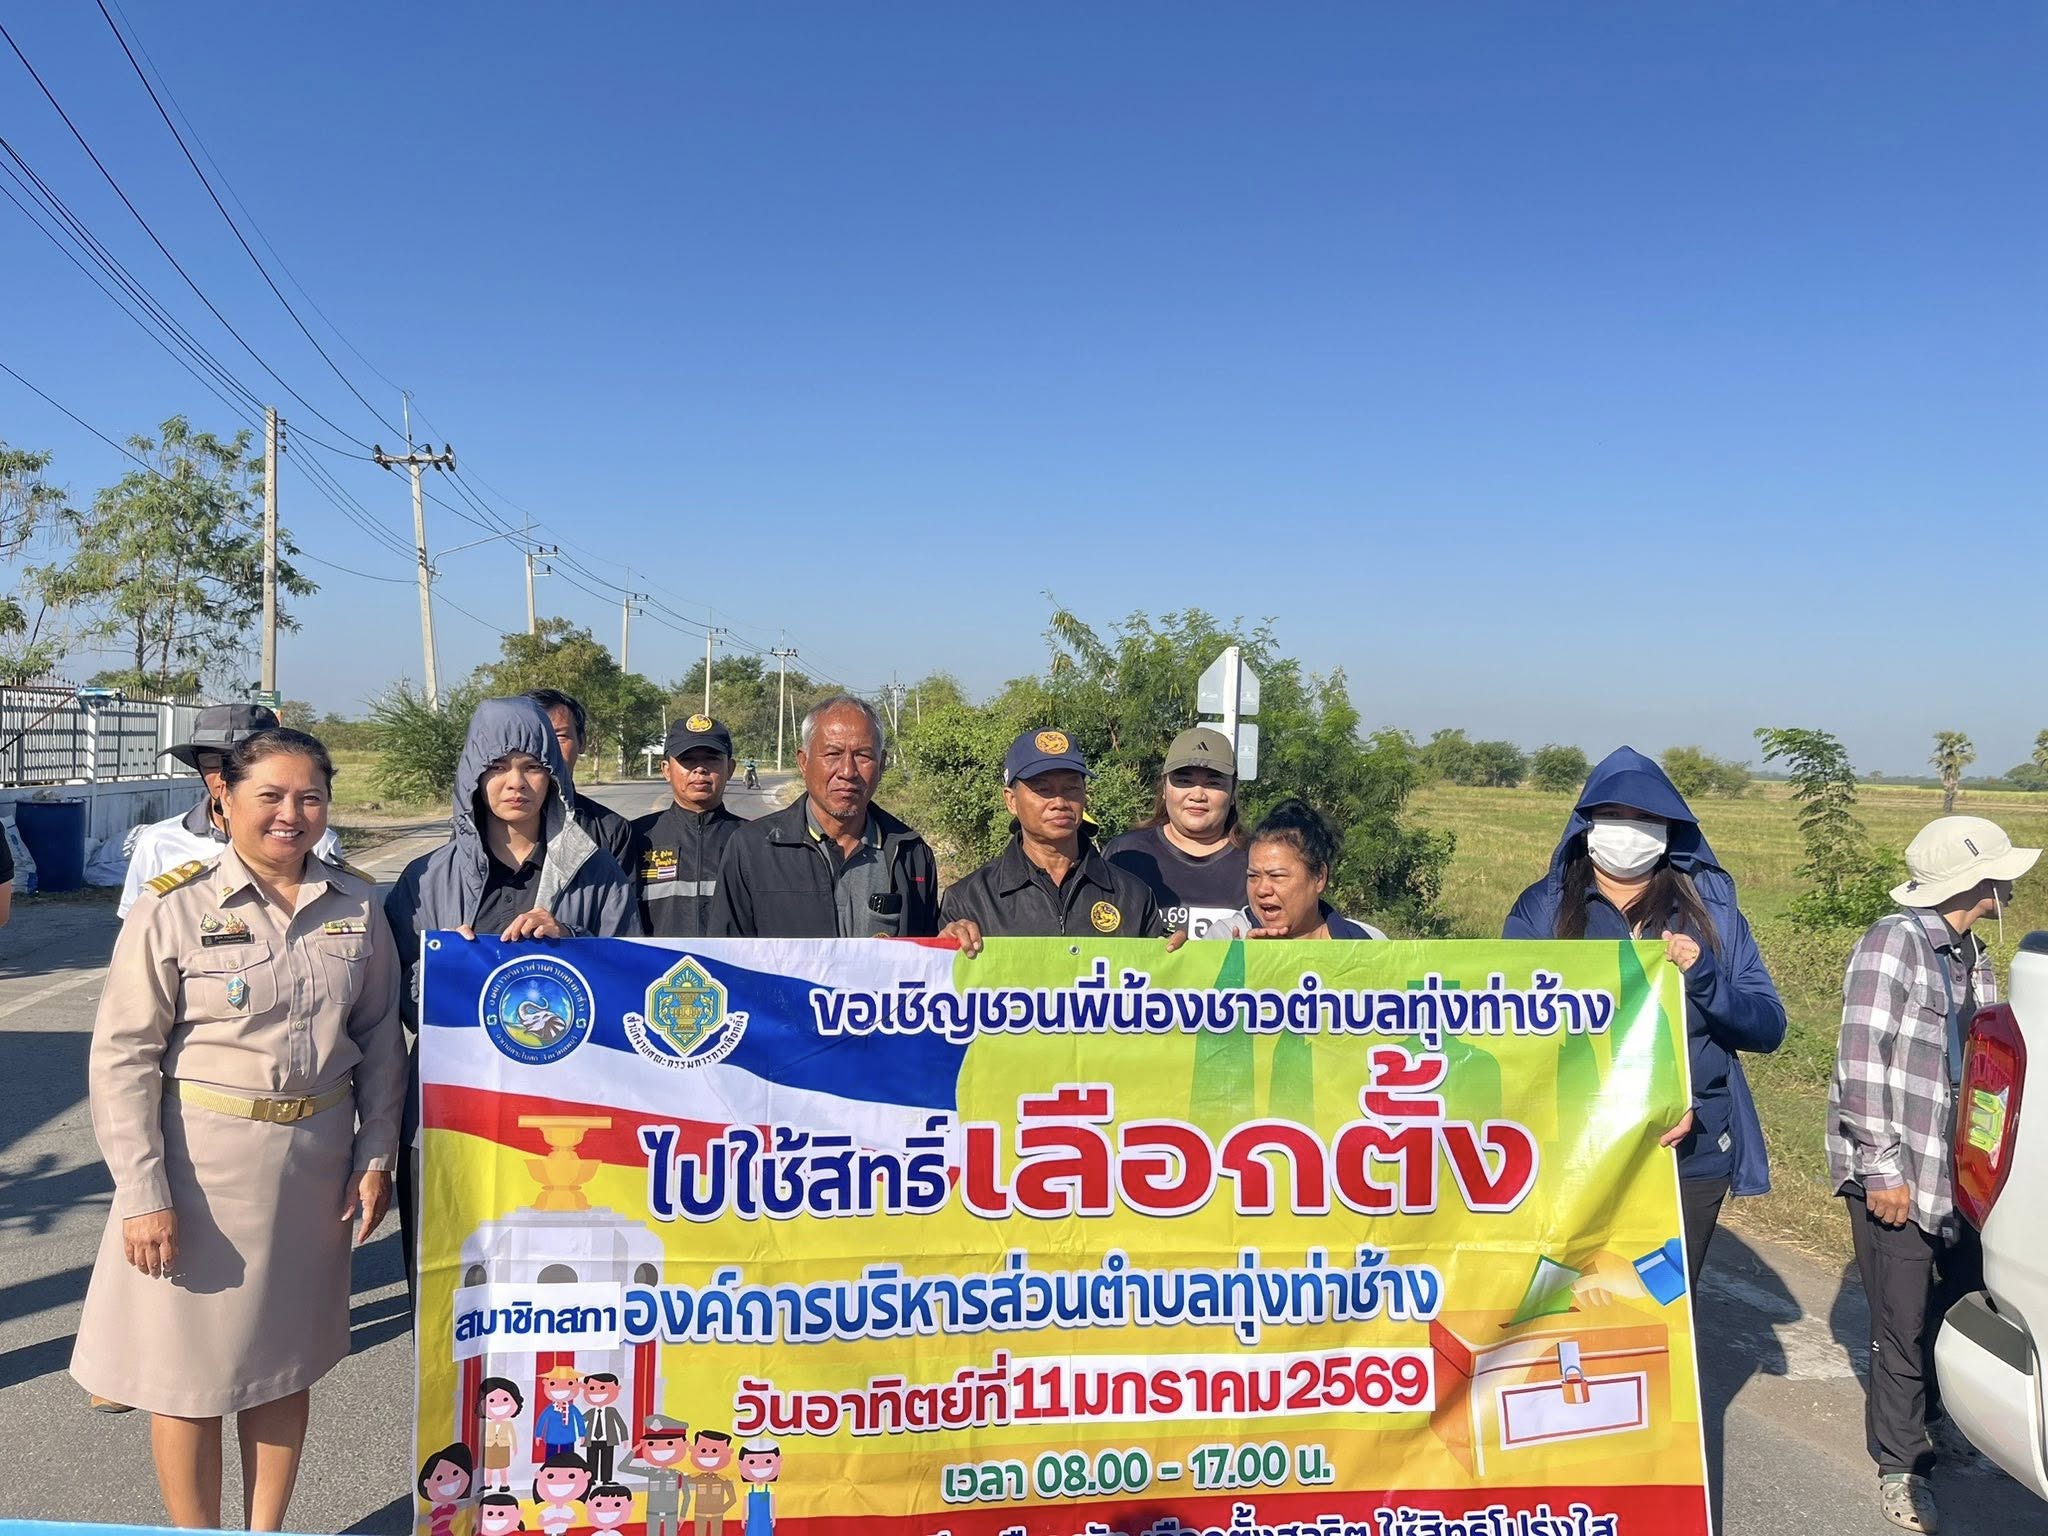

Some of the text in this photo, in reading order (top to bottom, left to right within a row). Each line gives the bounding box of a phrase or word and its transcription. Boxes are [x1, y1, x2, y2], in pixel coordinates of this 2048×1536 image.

[812, 961, 1611, 1046] ขอเชิญชวนพี่น้องชาวตำบลทุ่งท่าช้าง
[646, 1050, 1533, 1214] ไปใช้สิทธิ์ เลือกตั้ง
[456, 1252, 1438, 1342] สมาชิกสภา องค์การบริหารส่วนตำบลทุ่งท่าช้าง
[945, 1462, 1021, 1498] เวลา
[1037, 1455, 1147, 1492] 08.00
[1192, 1447, 1281, 1485] 17.00
[1298, 1450, 1330, 1480] น.
